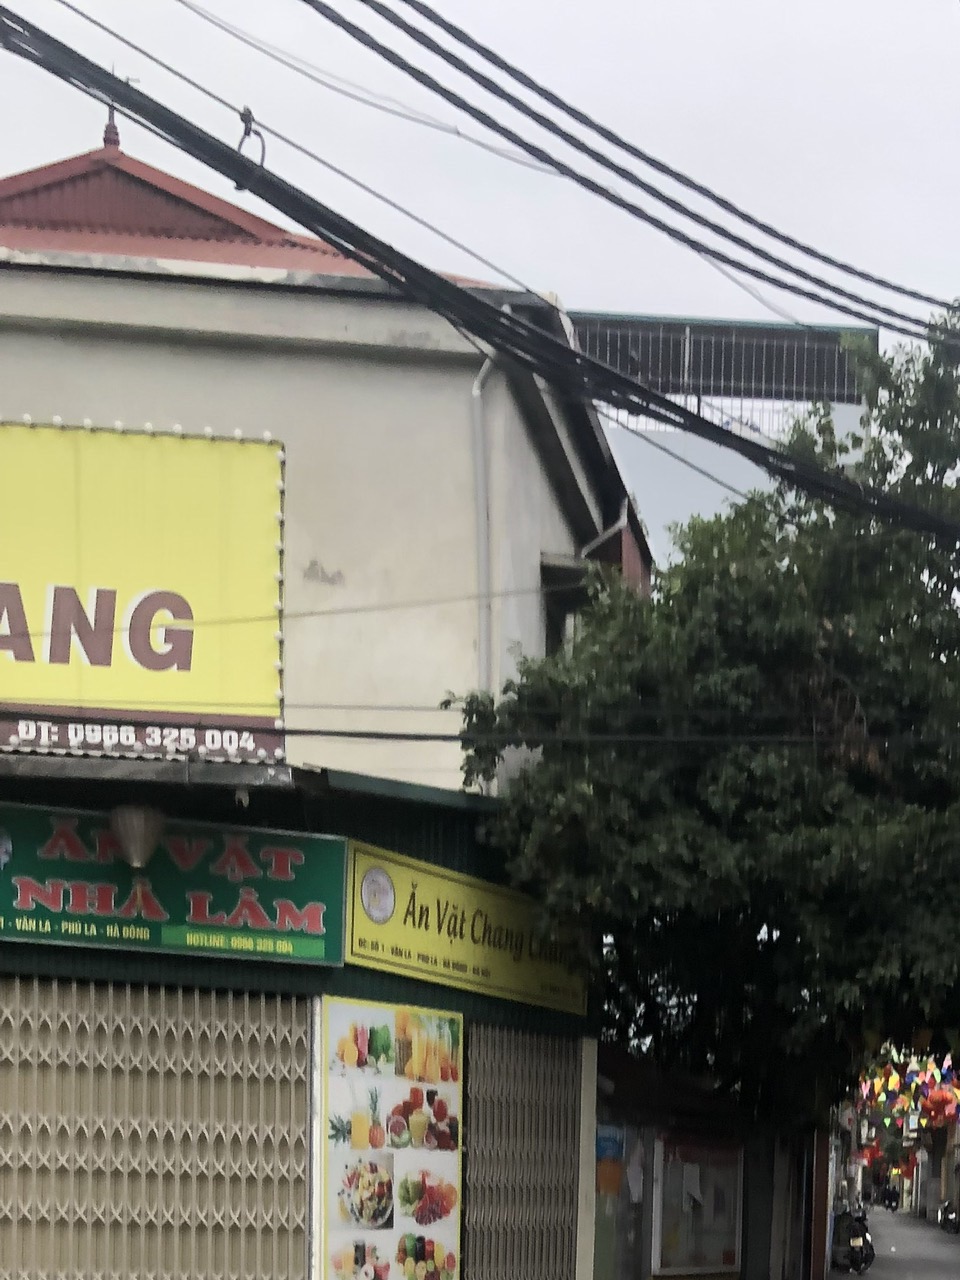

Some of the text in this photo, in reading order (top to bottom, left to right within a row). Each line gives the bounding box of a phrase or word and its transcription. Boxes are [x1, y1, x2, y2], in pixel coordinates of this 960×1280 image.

[18, 720, 58, 742] ĐT:
[68, 723, 136, 746] 0966
[205, 729, 255, 750] 004
[164, 832, 304, 882] VẶT
[15, 915, 36, 932] VĂN
[38, 918, 51, 933] LA
[84, 921, 97, 936] LA
[403, 881, 430, 931] Ăn
[436, 898, 466, 944] Vặt
[470, 908, 525, 962] Chang
